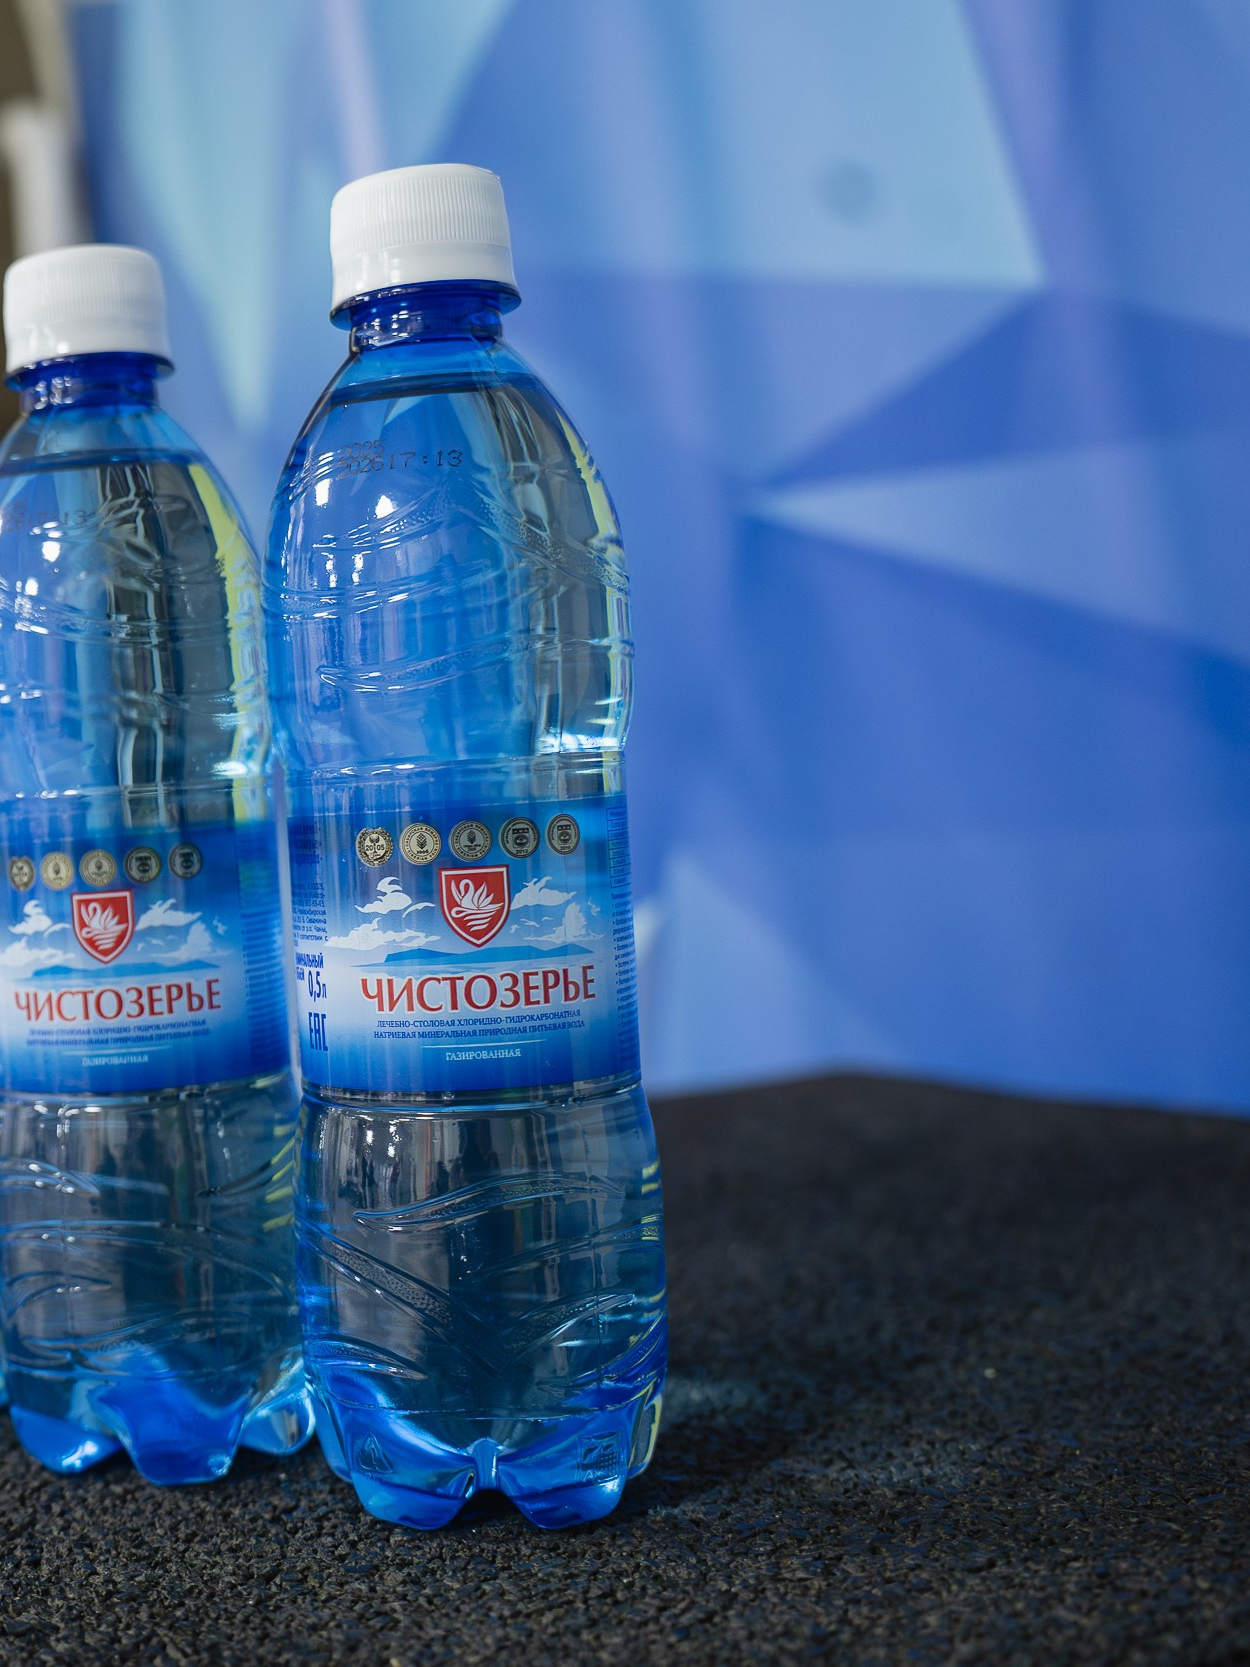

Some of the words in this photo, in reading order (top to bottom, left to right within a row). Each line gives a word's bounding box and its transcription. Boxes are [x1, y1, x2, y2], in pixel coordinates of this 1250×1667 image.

[389, 449, 463, 470] 17:13
[360, 964, 597, 1013] ЧИСТОЗЕРЬЕ
[14, 978, 222, 1022] ЧИСТОЗЕРЬЕ
[376, 1019, 456, 1029] ЛЕЧЕБНО-СТОЛОВАЯ
[457, 1009, 581, 1027] ХЛОРИДНО-ГИДРОКАРБОНАТНАЯ
[374, 1031, 416, 1039] НАТРИЕВАЯ
[417, 1029, 477, 1039] МИНЕРАЛЬНАЯ
[478, 1026, 528, 1037] ПРИРОДНАЯ
[528, 1022, 566, 1033] ПИТЬЕВАЯ
[567, 1020, 586, 1029] ВОДА
[445, 1048, 522, 1061] ГАЗИРОВАННАЯ
